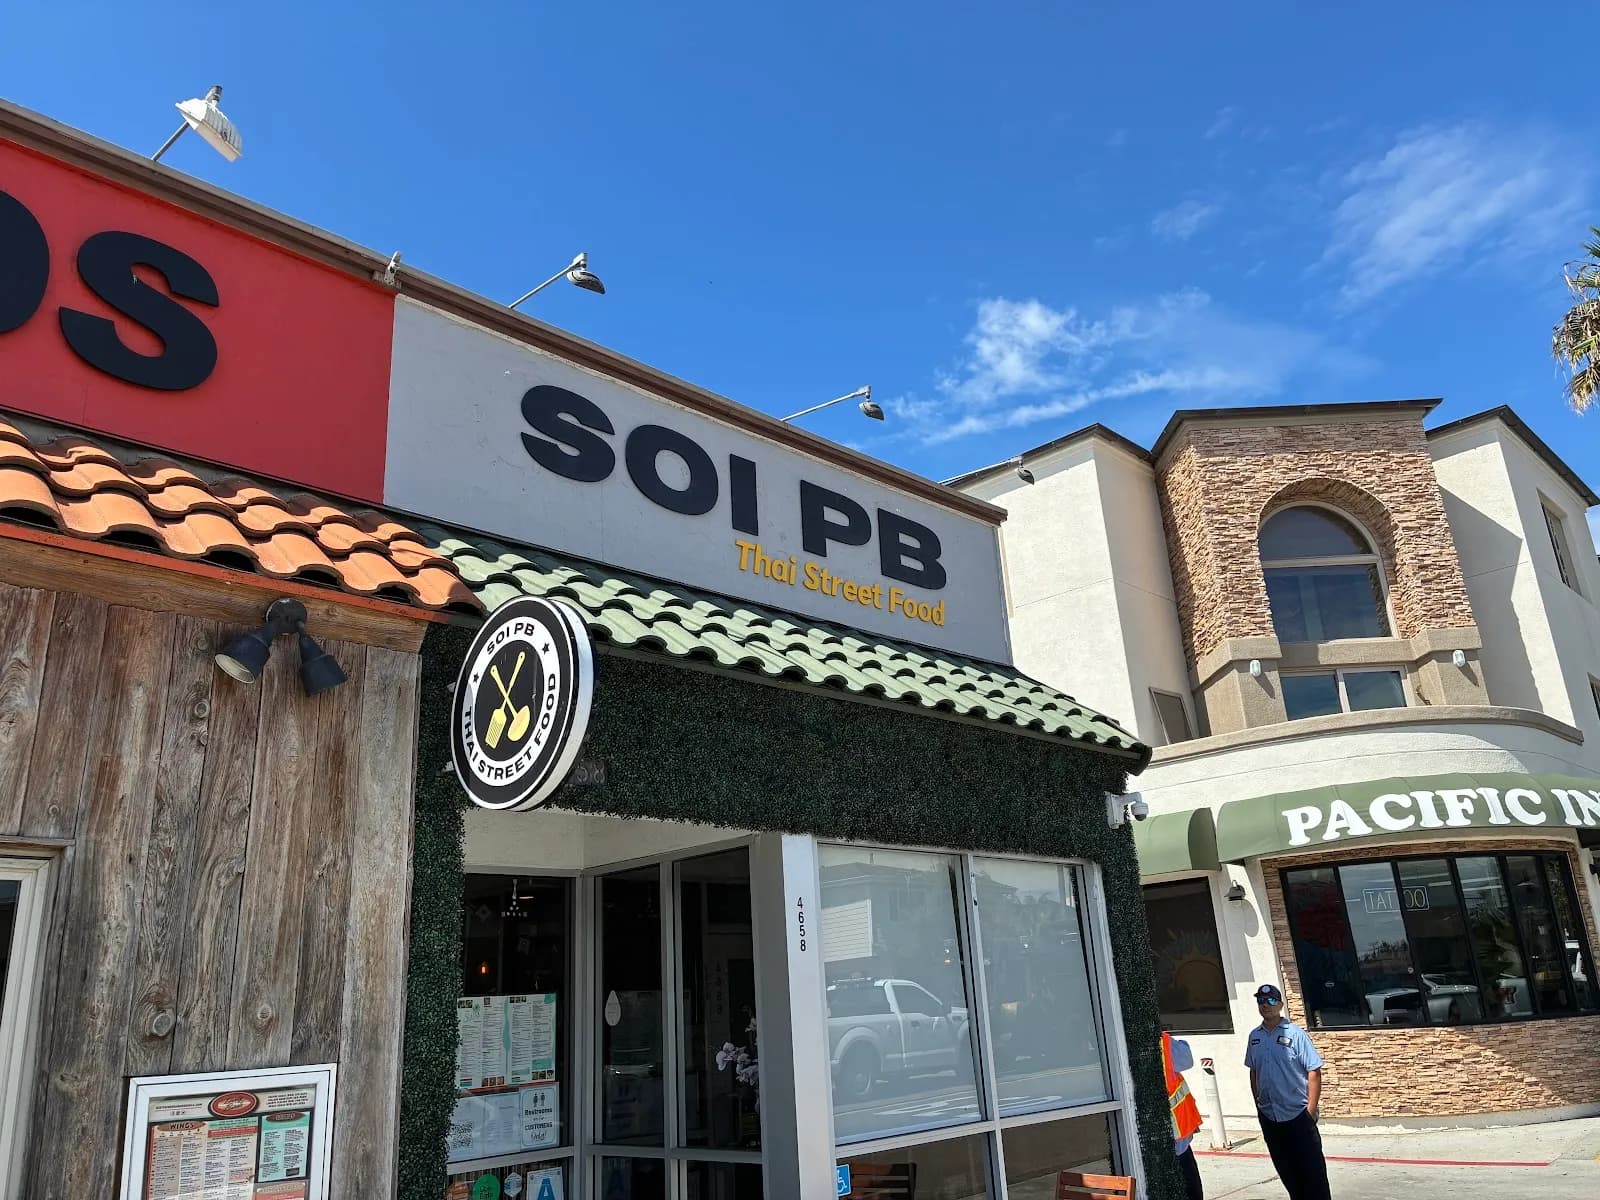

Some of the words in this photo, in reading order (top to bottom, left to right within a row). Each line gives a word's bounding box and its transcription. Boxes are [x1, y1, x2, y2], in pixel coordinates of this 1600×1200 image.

[520, 384, 758, 536] SOI
[800, 479, 947, 591] PB
[735, 540, 797, 585] Thai
[803, 561, 884, 609] Street
[889, 586, 945, 627] Food
[486, 626, 511, 656] SOI
[513, 622, 536, 637] PB
[463, 706, 479, 763] THAI
[477, 745, 533, 781] STREET
[534, 673, 556, 746] FOOD
[1282, 787, 1546, 846] PACIFIC
[796, 896, 806, 952] 4658
[1365, 888, 1426, 910] TATOO
[170, 1121, 195, 1130] WINGS
